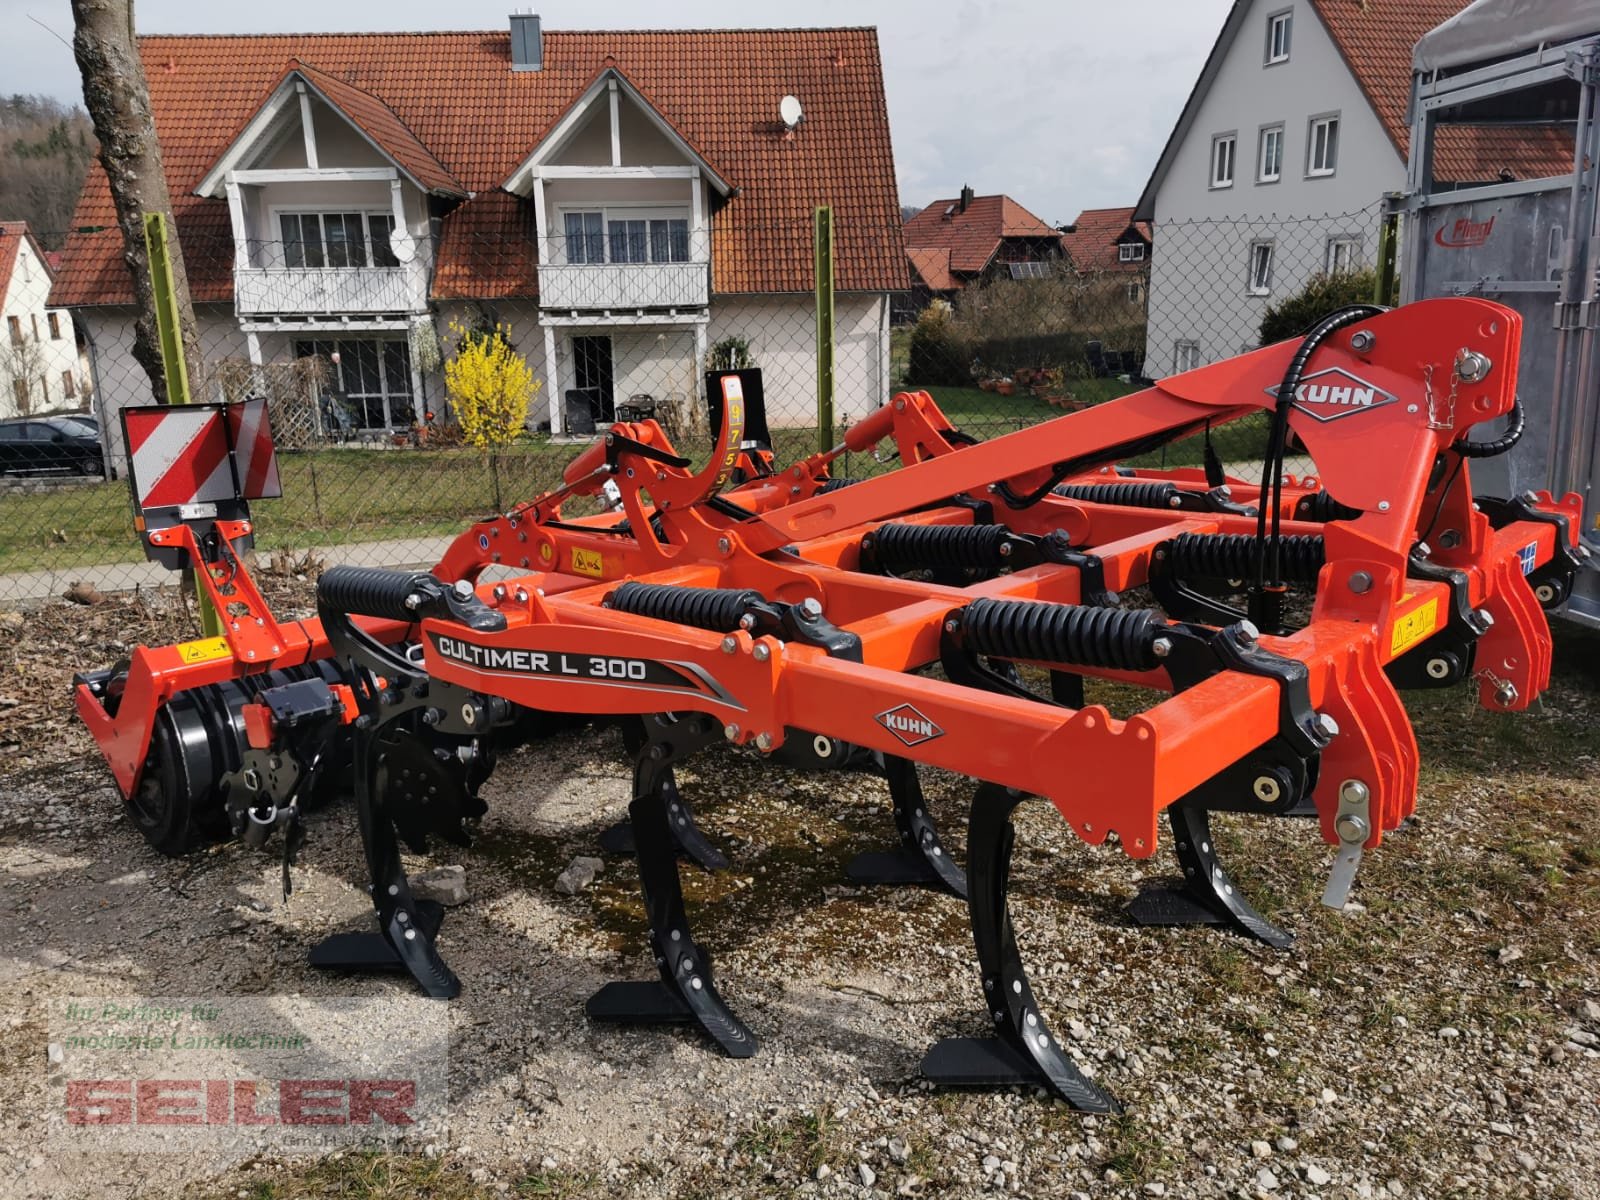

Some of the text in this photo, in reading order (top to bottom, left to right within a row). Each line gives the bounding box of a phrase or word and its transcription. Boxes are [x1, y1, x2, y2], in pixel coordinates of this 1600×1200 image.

[1452, 215, 1495, 241] Fliegl
[731, 404, 741, 419] 9
[731, 429, 740, 443] 7
[724, 453, 735, 466] 5
[716, 473, 727, 485] 3
[438, 636, 647, 681] CULTIMER L 300
[885, 713, 933, 737] KUHN
